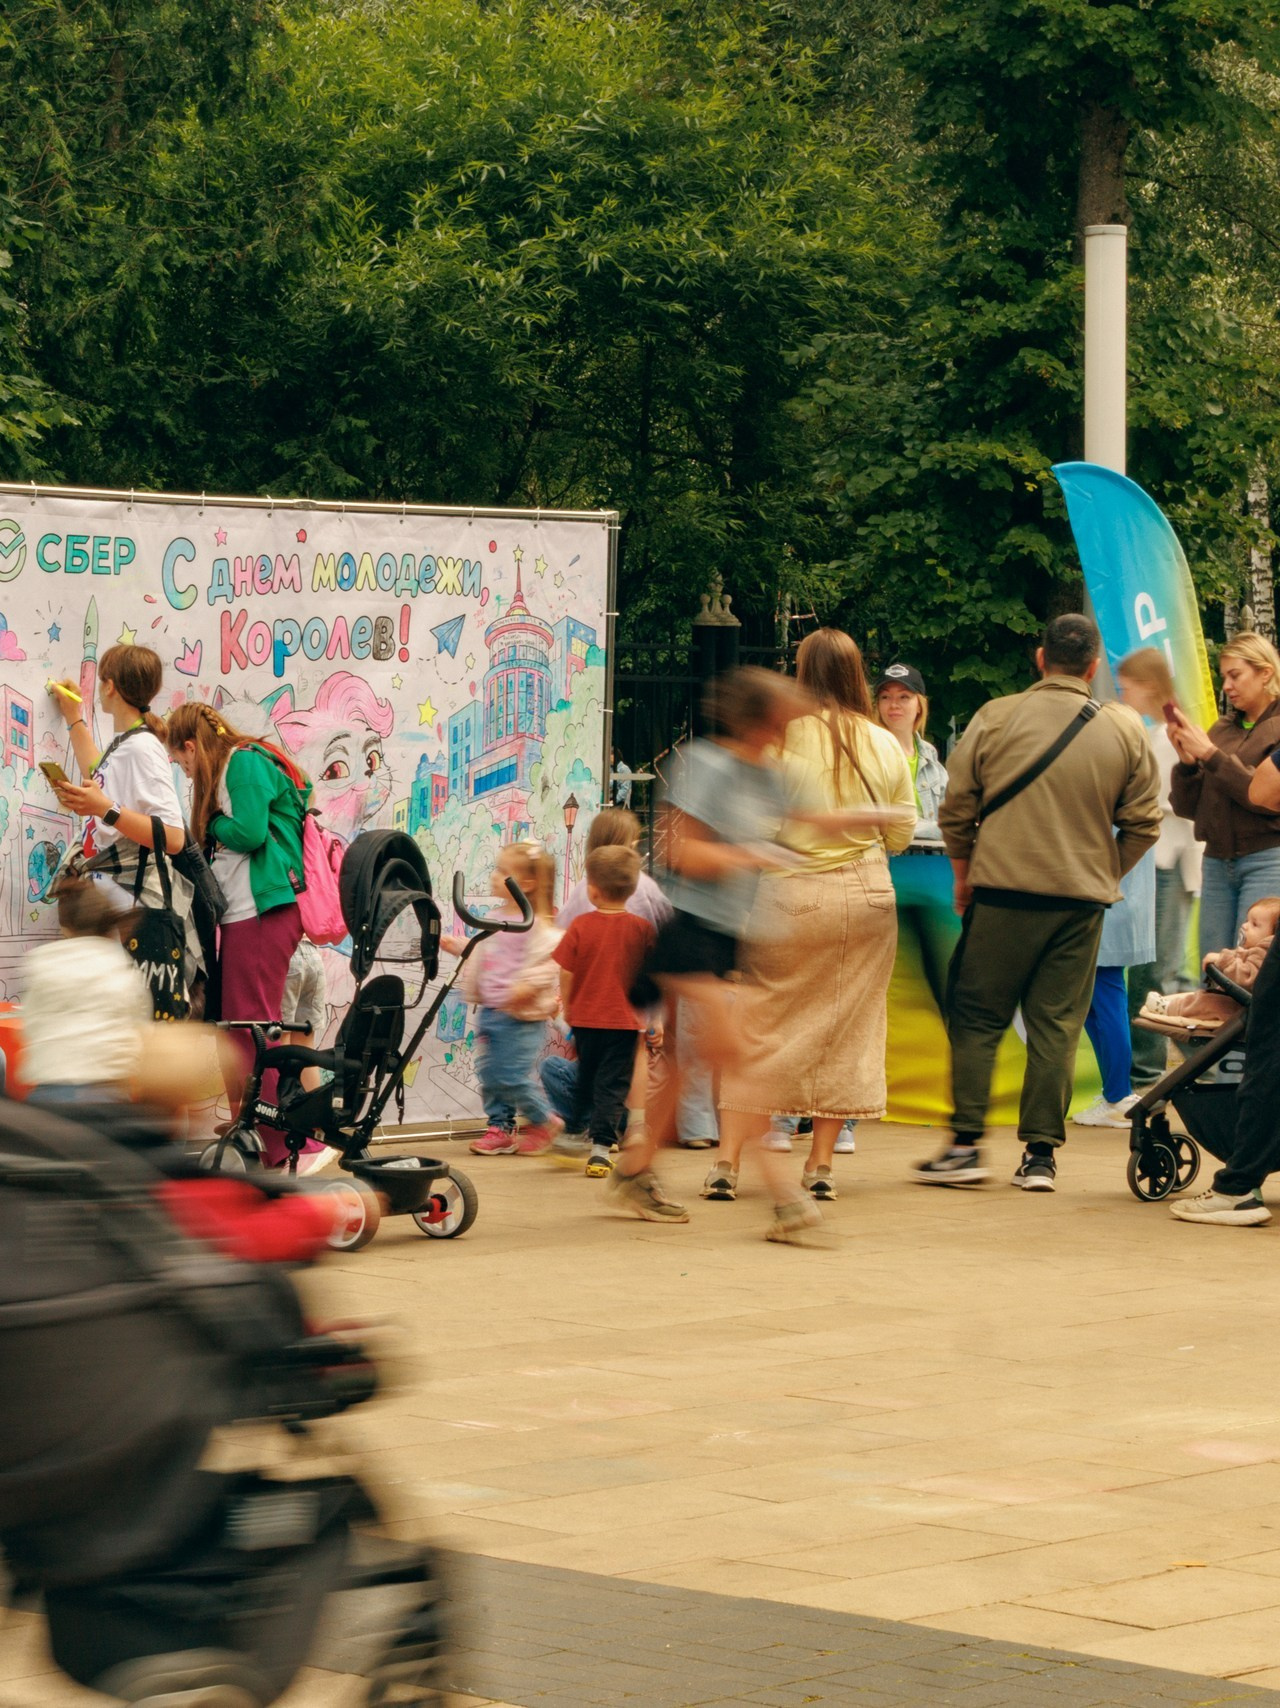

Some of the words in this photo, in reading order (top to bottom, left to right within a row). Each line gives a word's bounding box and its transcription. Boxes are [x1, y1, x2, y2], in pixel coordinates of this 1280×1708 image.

[36, 533, 136, 575] СБЕР
[162, 537, 198, 610] С
[207, 554, 302, 606] днем
[220, 603, 412, 677] Королев!
